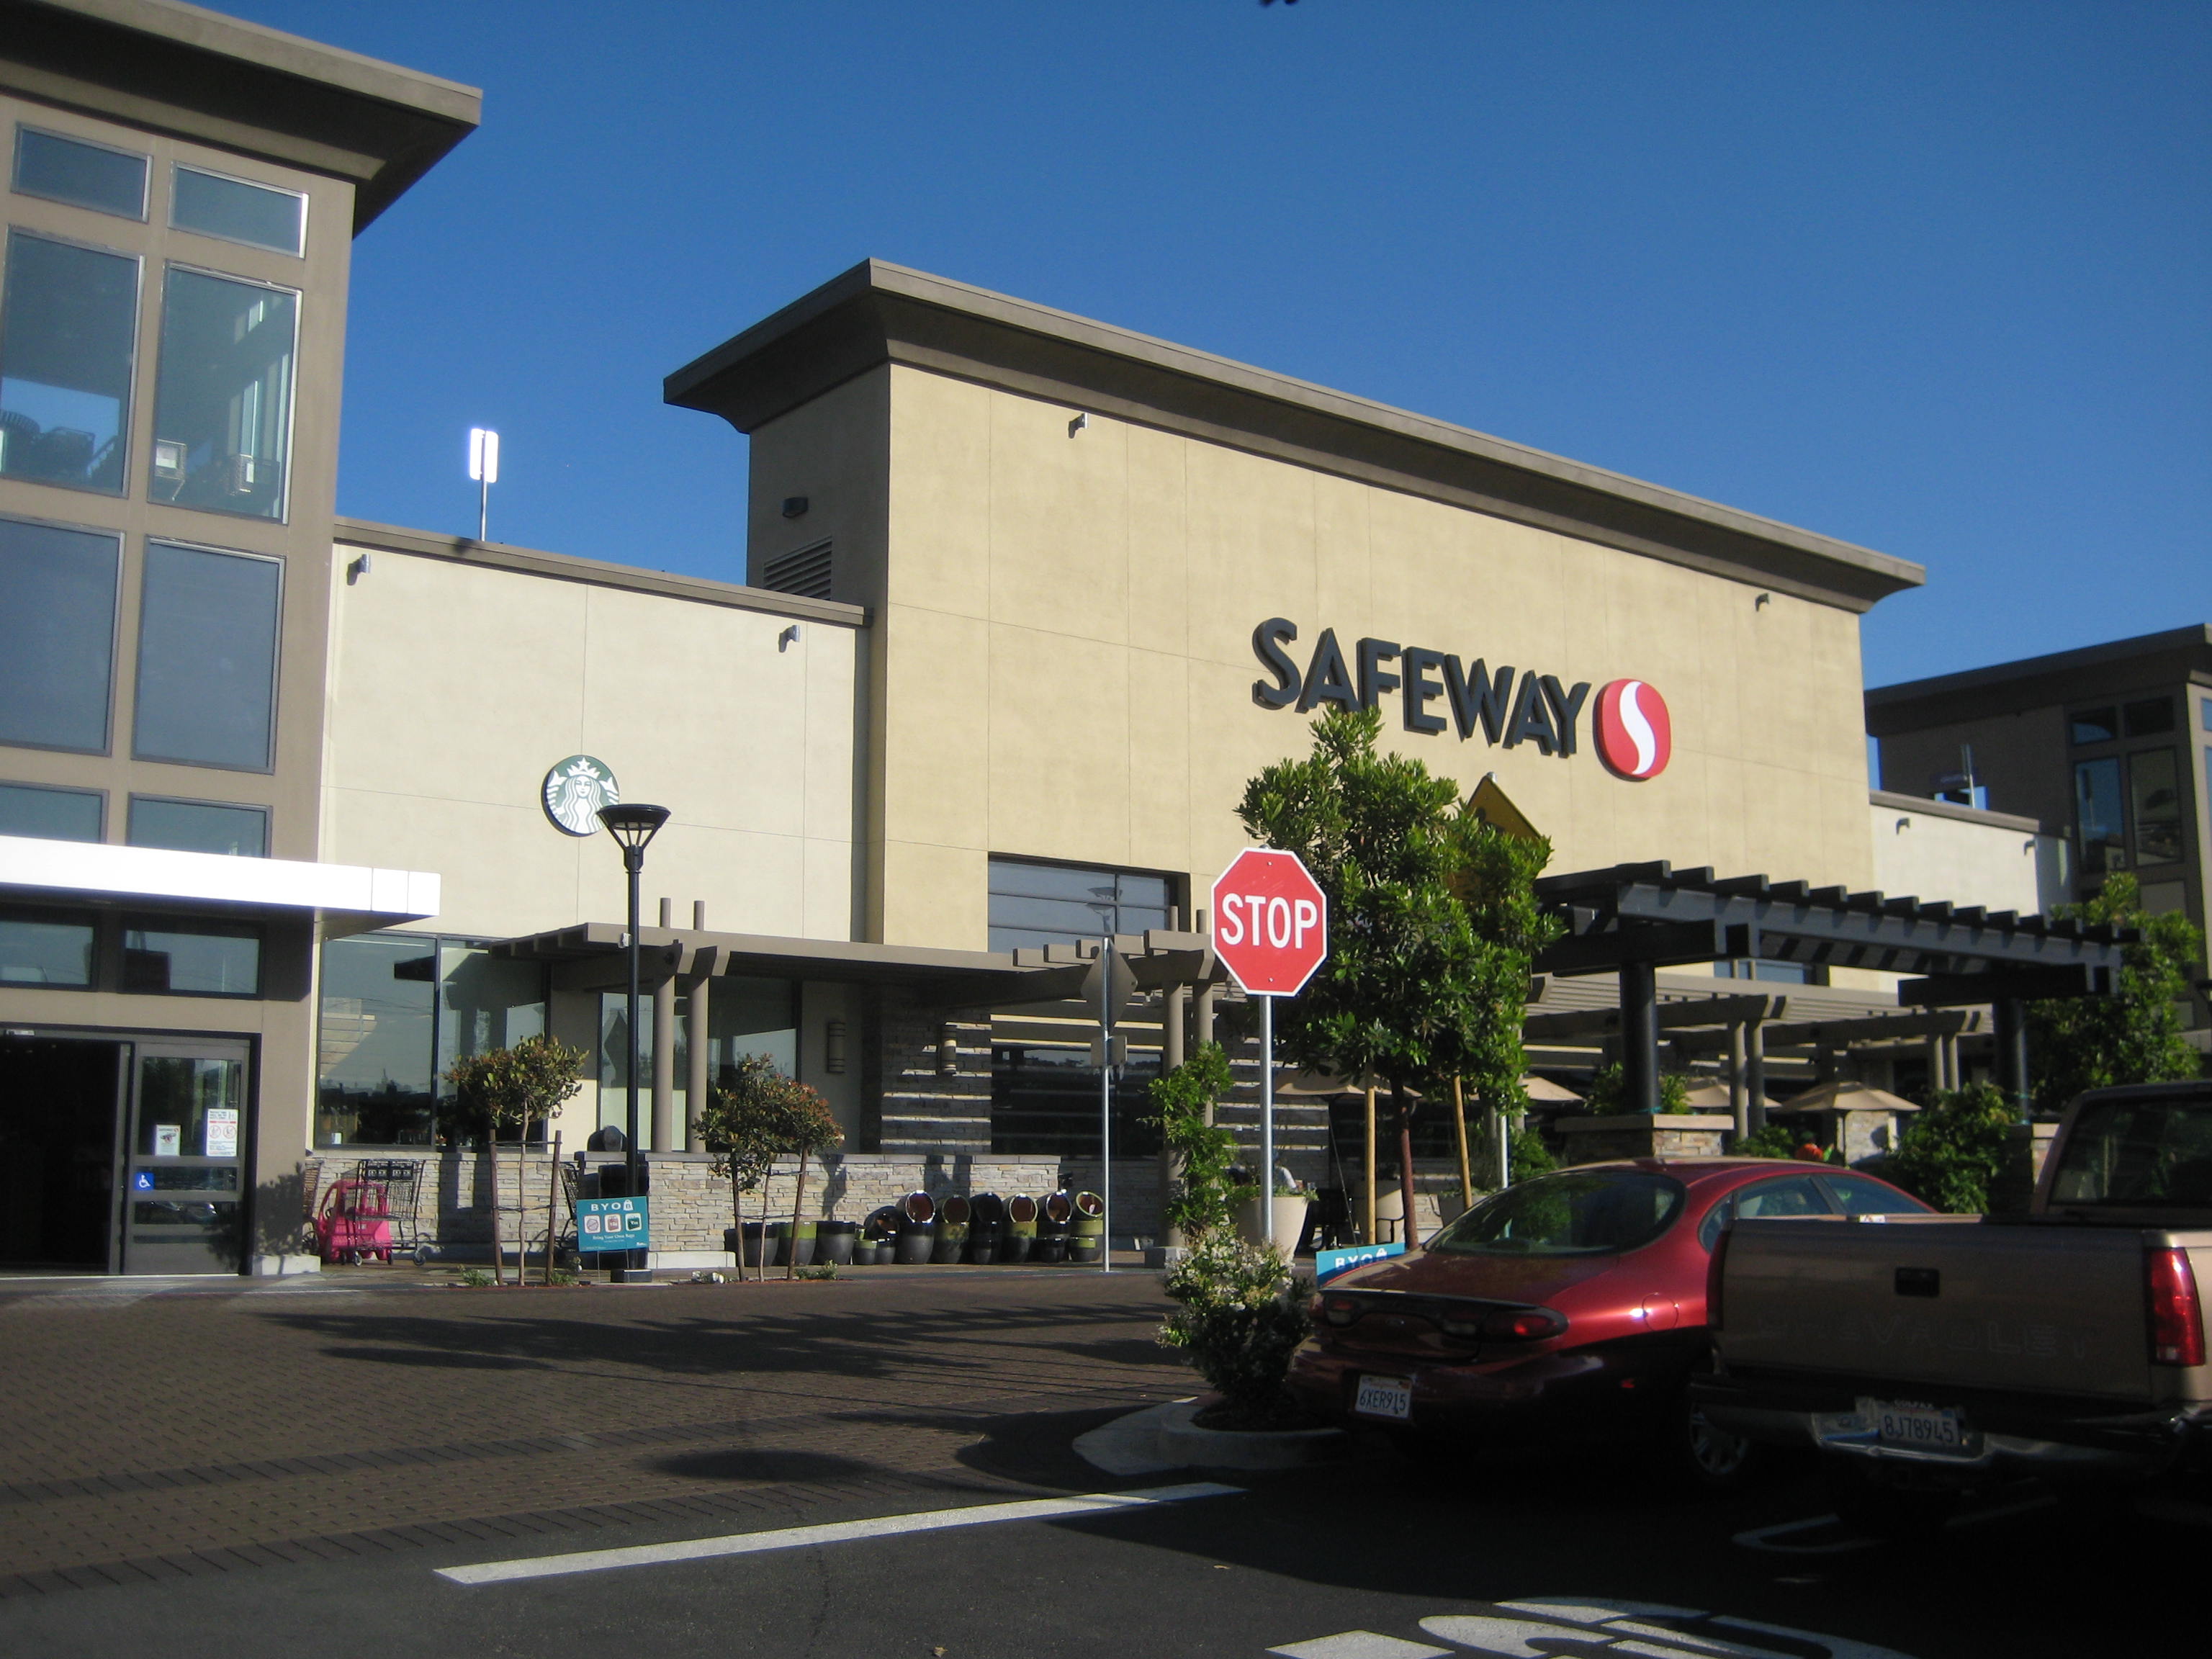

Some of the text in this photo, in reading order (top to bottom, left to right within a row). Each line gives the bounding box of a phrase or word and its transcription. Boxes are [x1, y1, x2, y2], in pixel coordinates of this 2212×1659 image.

[1252, 617, 1592, 758] SAFEWAY
[1220, 893, 1318, 949] STOP
[1359, 1388, 1406, 1411] 6XER915
